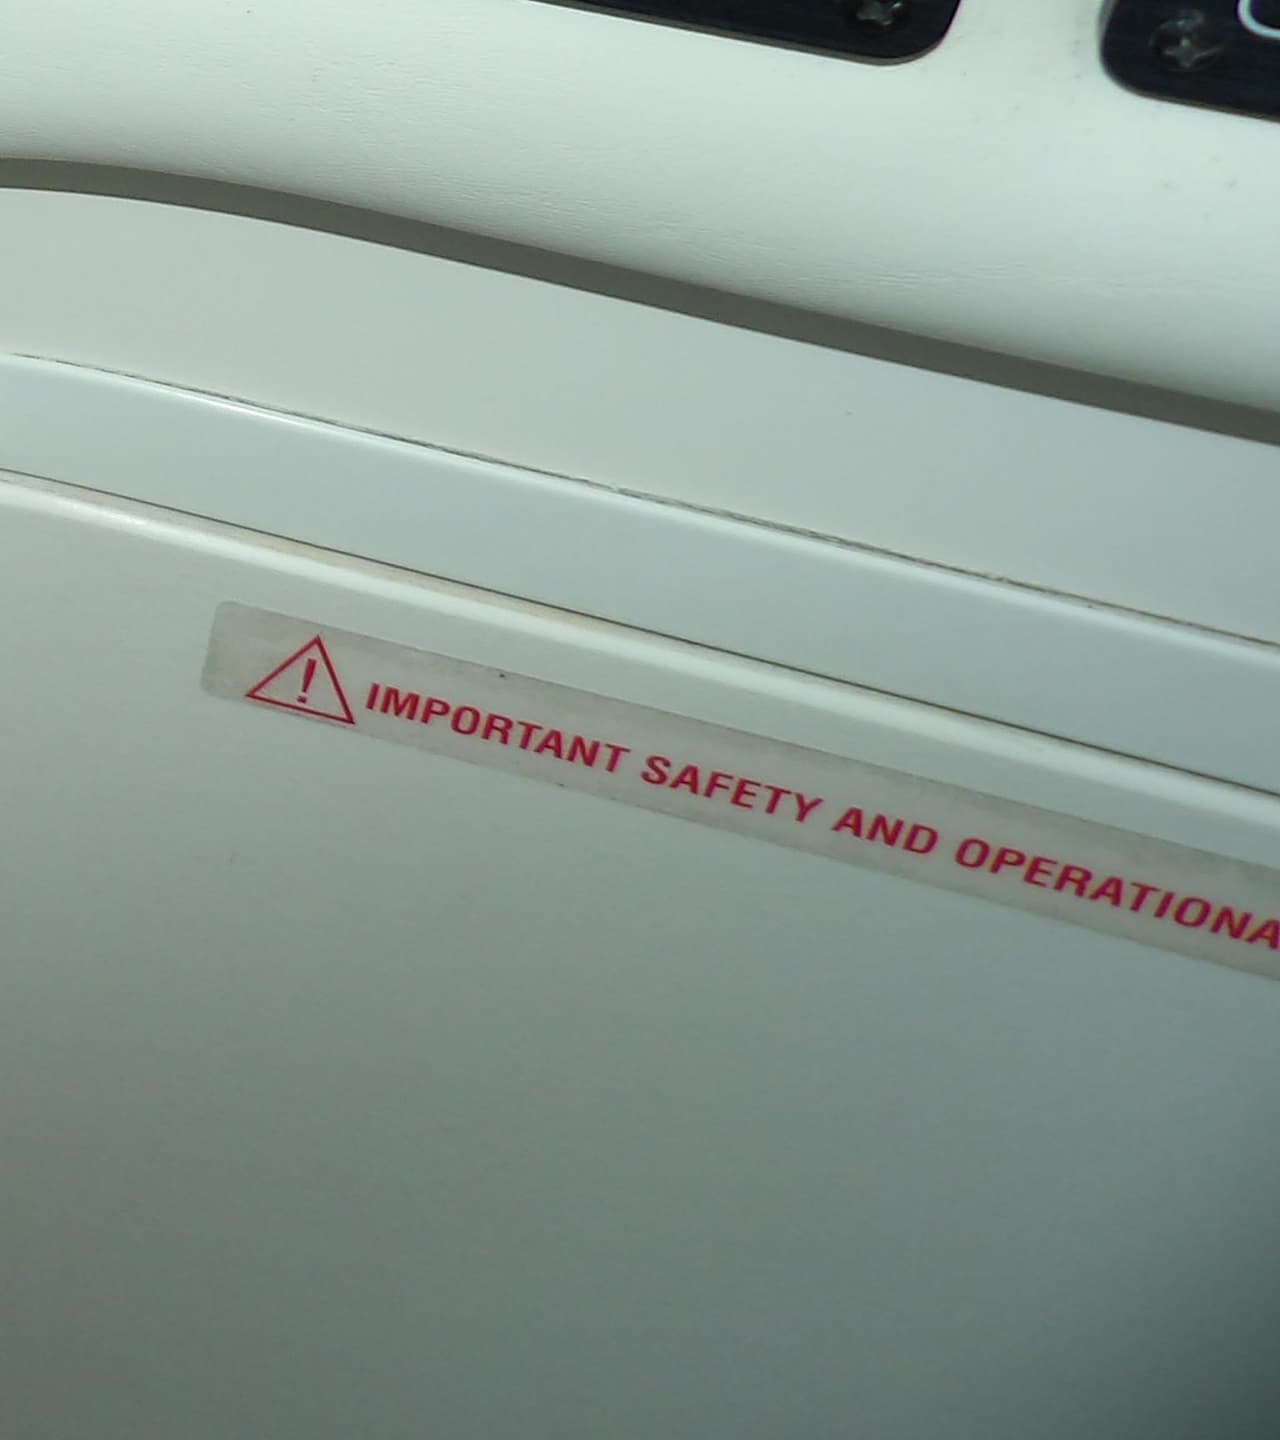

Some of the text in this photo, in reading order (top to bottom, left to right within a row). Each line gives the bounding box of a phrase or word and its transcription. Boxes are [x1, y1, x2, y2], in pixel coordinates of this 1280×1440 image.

[365, 682, 1280, 951] IMPORTANT SAFETY AND OPERATIONA
